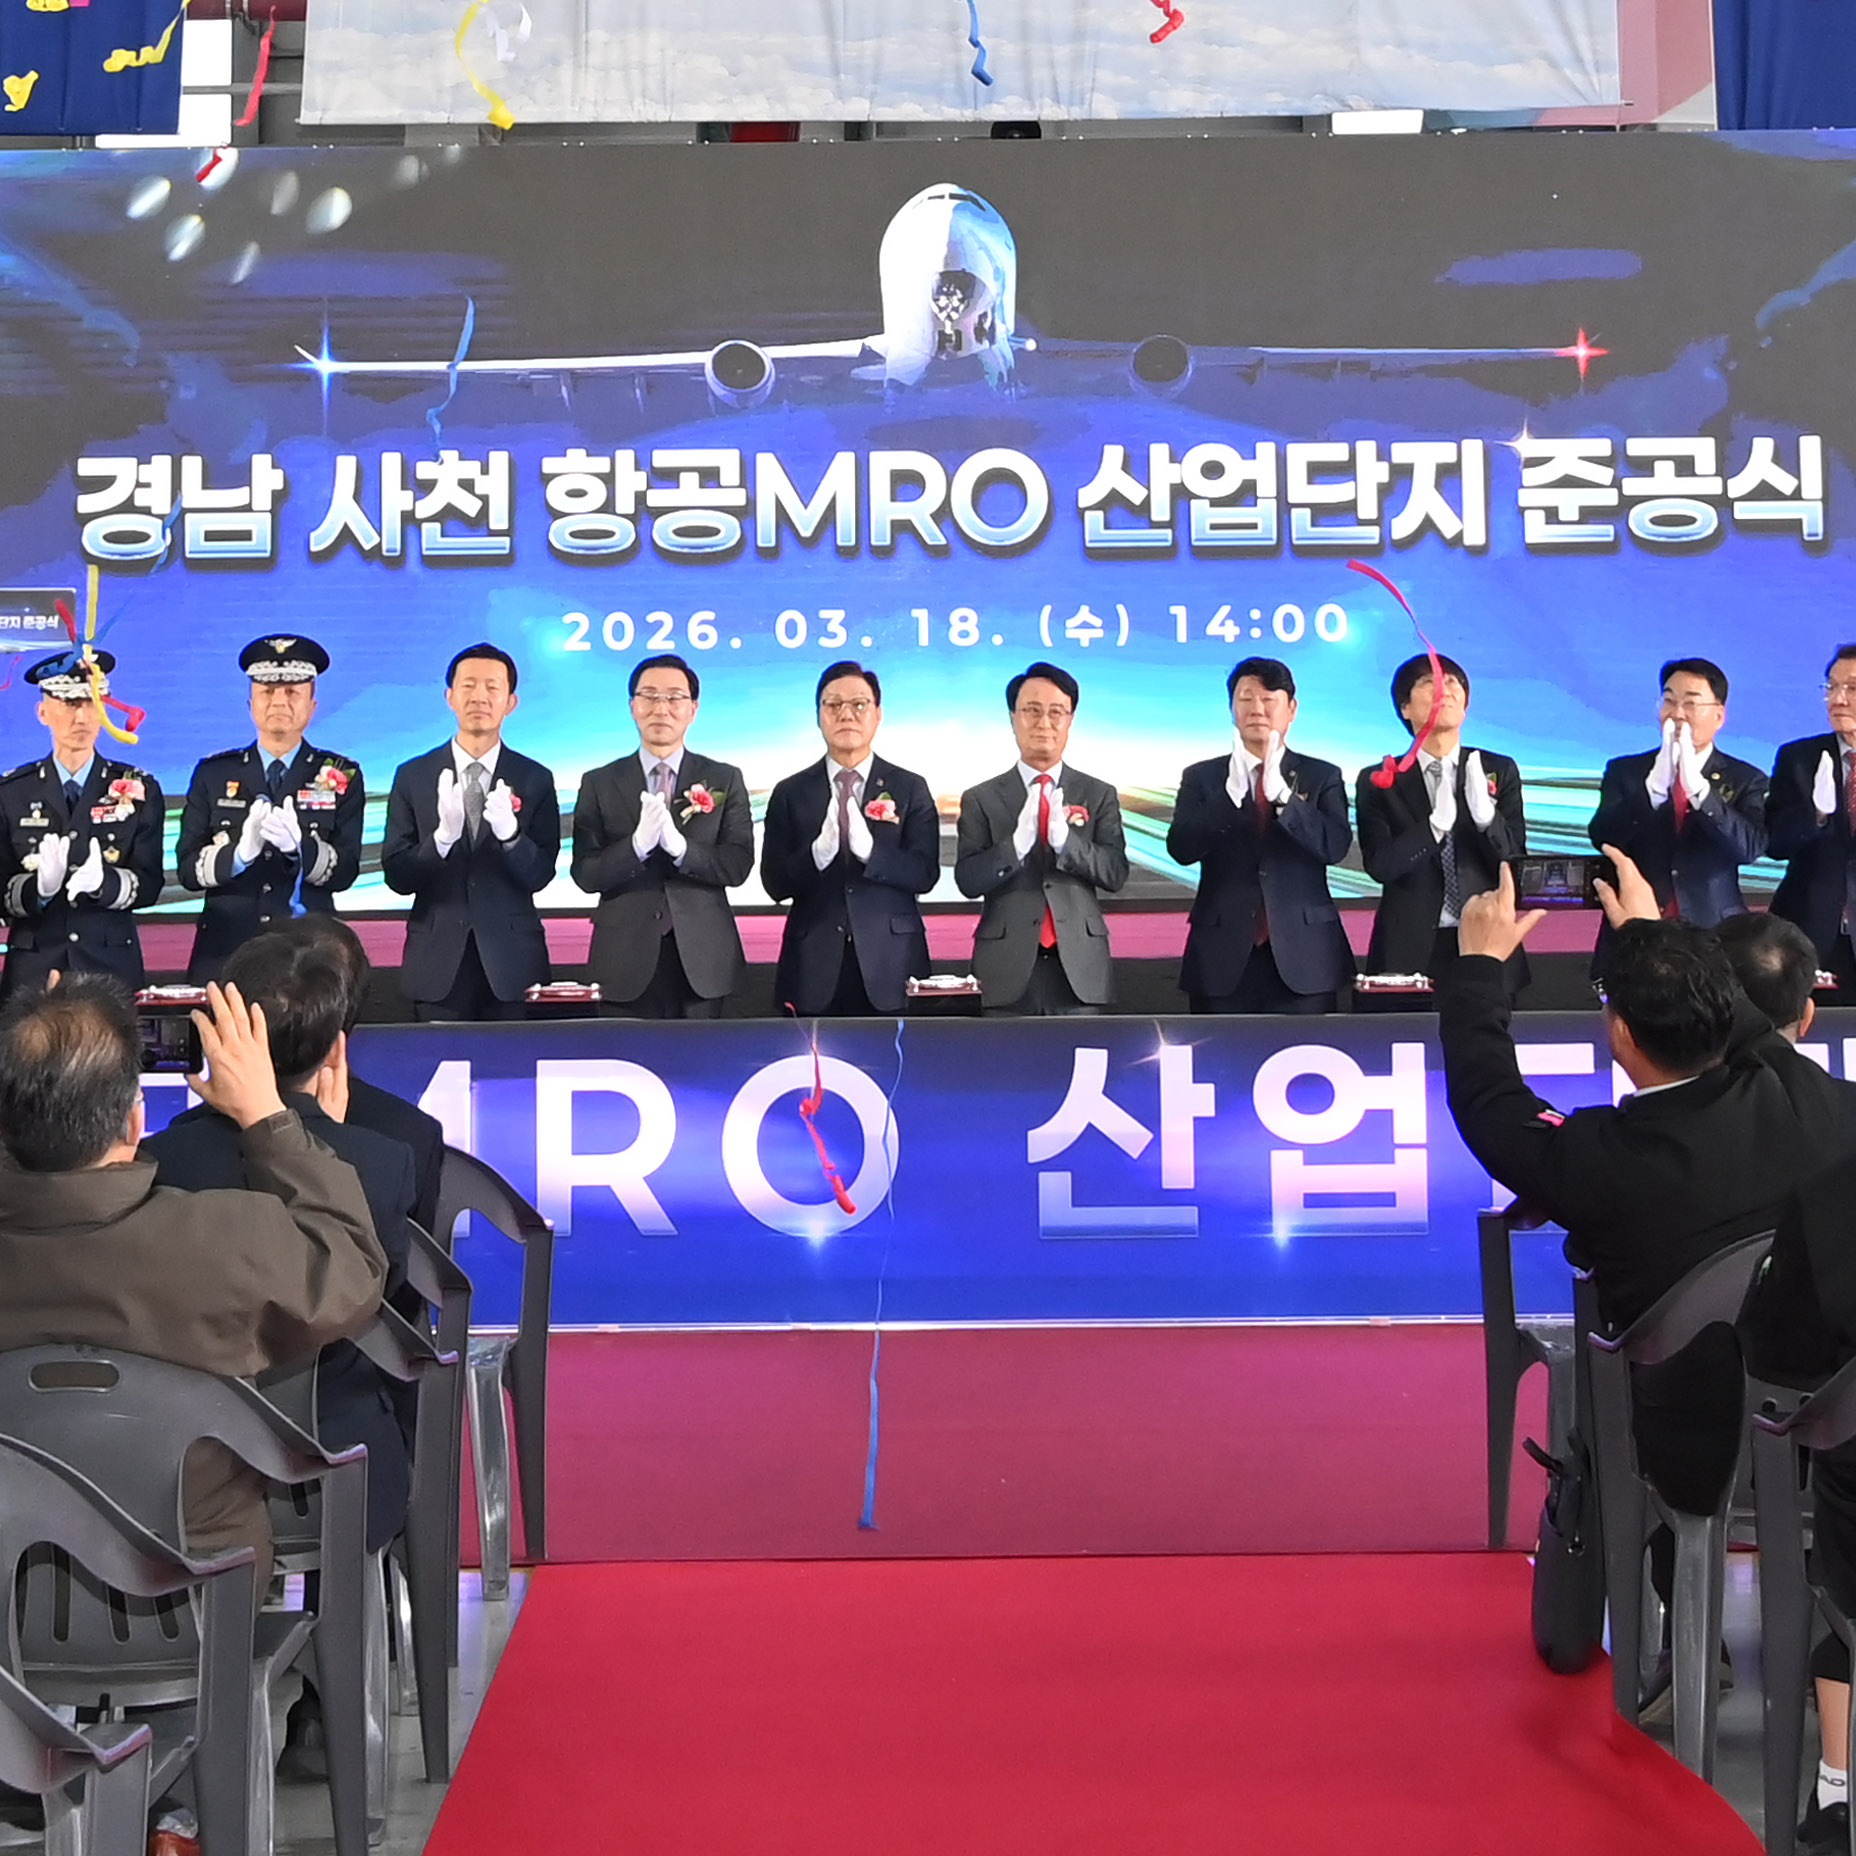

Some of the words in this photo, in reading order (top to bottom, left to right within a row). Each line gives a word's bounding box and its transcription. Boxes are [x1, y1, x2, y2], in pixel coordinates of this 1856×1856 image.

[76, 451, 284, 561] 경남
[308, 448, 510, 557] 사천
[545, 446, 1048, 555] 항공MRO
[1077, 439, 1486, 549] 산업단지
[1518, 433, 1824, 546] 준공식
[561, 610, 743, 651] 2026.
[774, 608, 873, 649] 03.
[910, 606, 1003, 647] 18.
[1039, 603, 1131, 649] (수)
[1168, 603, 1347, 644] 14:00
